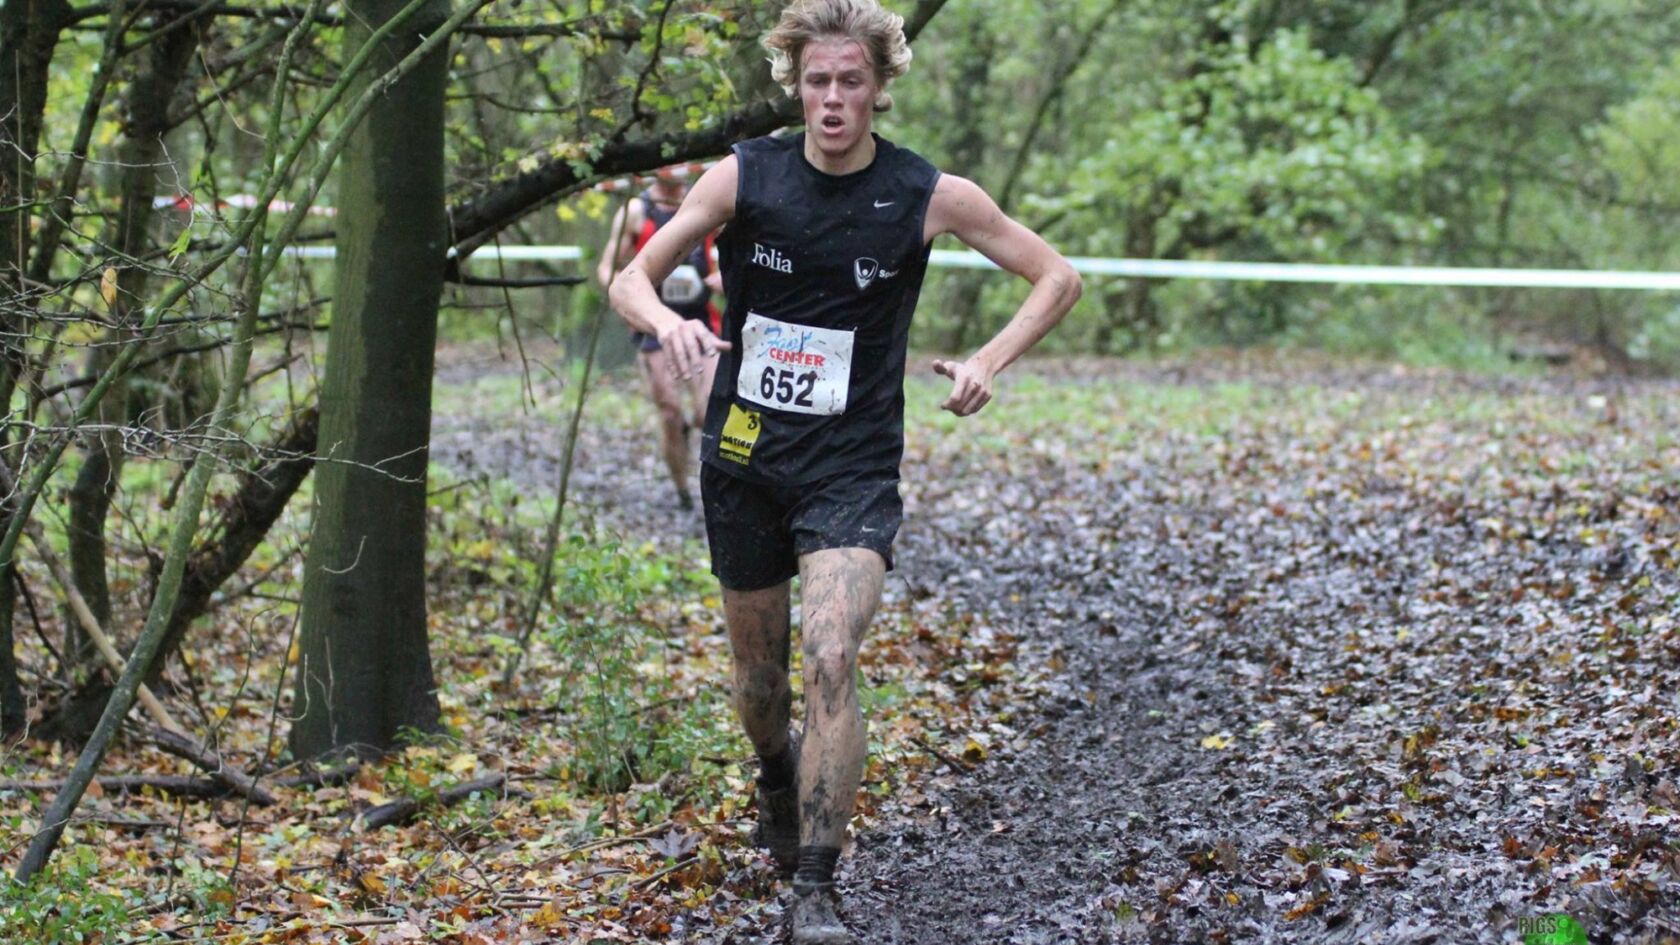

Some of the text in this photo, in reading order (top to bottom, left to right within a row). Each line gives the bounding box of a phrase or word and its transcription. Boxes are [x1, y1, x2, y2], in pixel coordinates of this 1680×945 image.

[752, 243, 793, 273] Folia
[770, 348, 825, 367] CENTER
[761, 366, 817, 407] 652
[747, 414, 758, 430] 3
